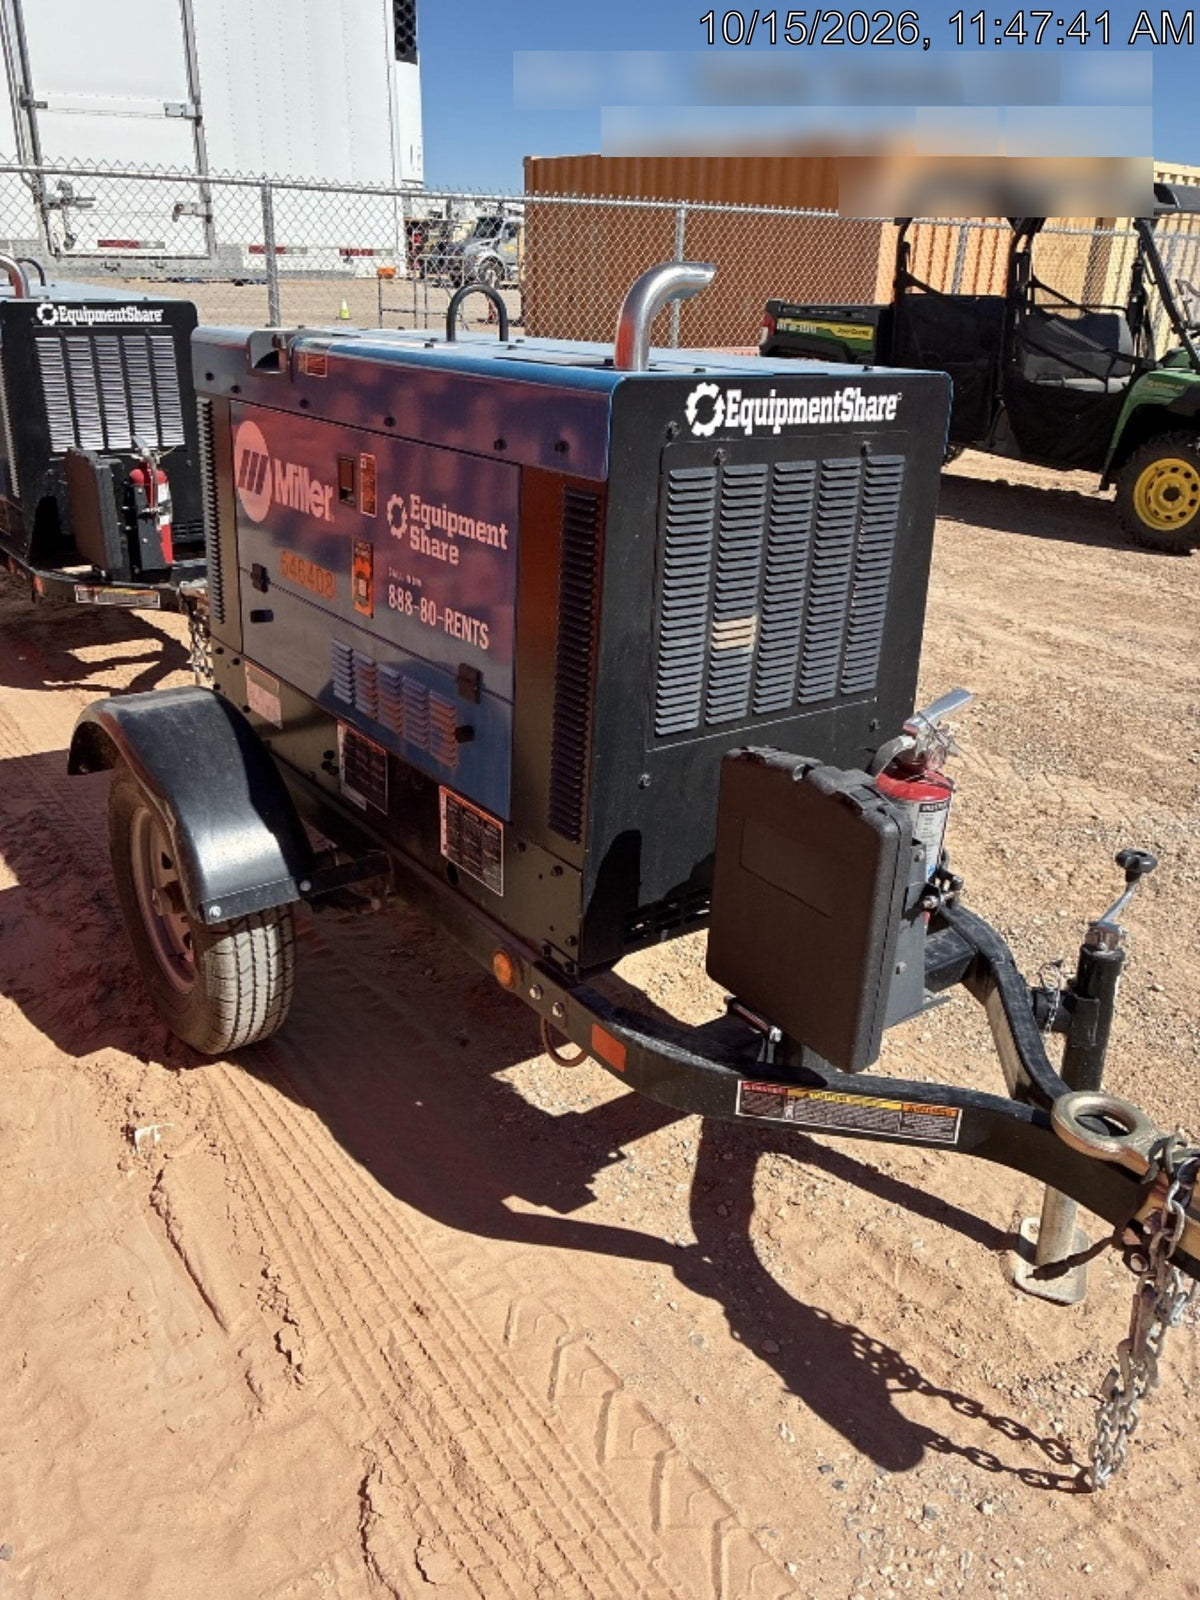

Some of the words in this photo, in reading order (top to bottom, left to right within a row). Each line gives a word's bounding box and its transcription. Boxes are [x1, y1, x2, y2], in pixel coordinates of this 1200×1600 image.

[58, 305, 164, 326] EquipmentShare
[724, 387, 899, 435] EquipmentShare
[273, 458, 334, 522] Miller
[409, 493, 509, 551] Equipment
[409, 525, 460, 566] Share
[388, 584, 490, 650] 888-80-RENTS
